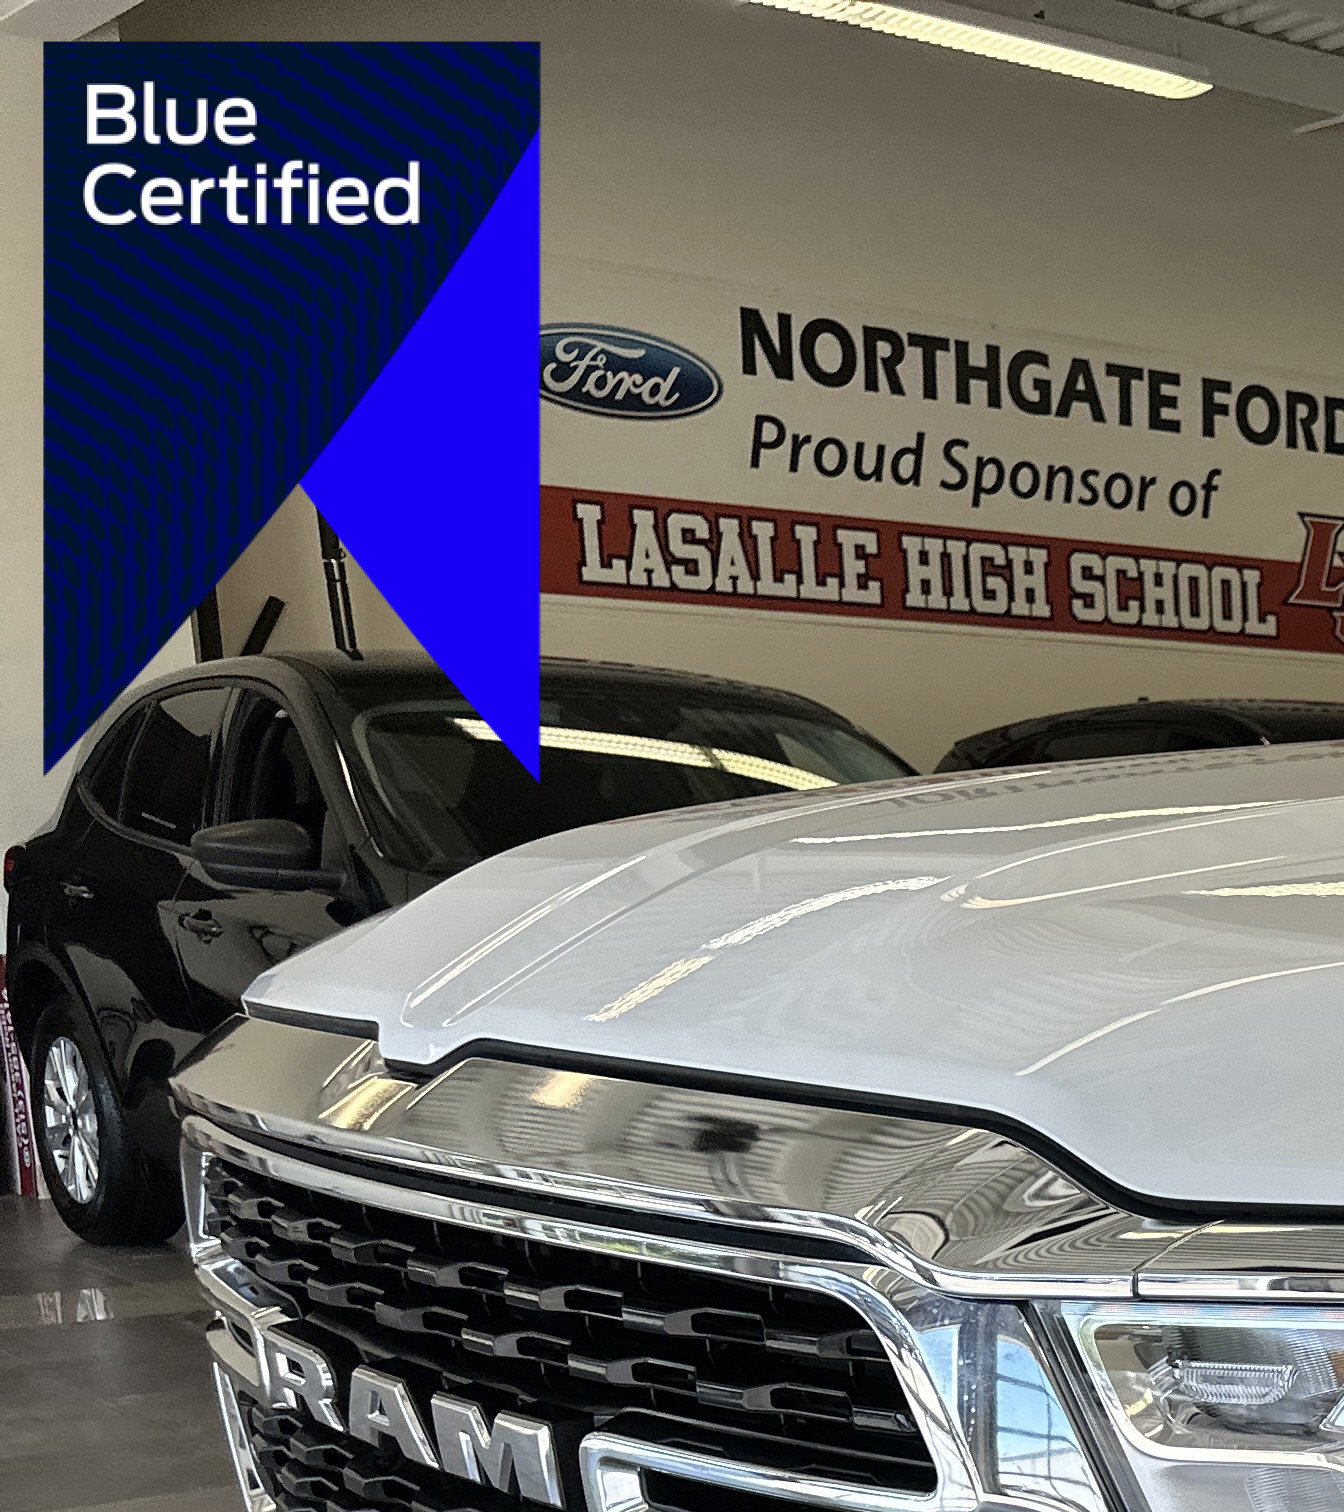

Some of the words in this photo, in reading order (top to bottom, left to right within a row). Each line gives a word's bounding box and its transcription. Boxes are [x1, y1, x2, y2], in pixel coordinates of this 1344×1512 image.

[542, 335, 681, 409] Ford
[739, 306, 1182, 434] NORTHGATE
[749, 414, 928, 488] Proud
[939, 437, 1158, 509] Sponsor
[1169, 467, 1223, 520] of
[574, 500, 883, 606] LASALLE
[900, 533, 1053, 621] HIGH
[1068, 550, 1279, 638] SCHOOL
[266, 1322, 568, 1510] RAM
